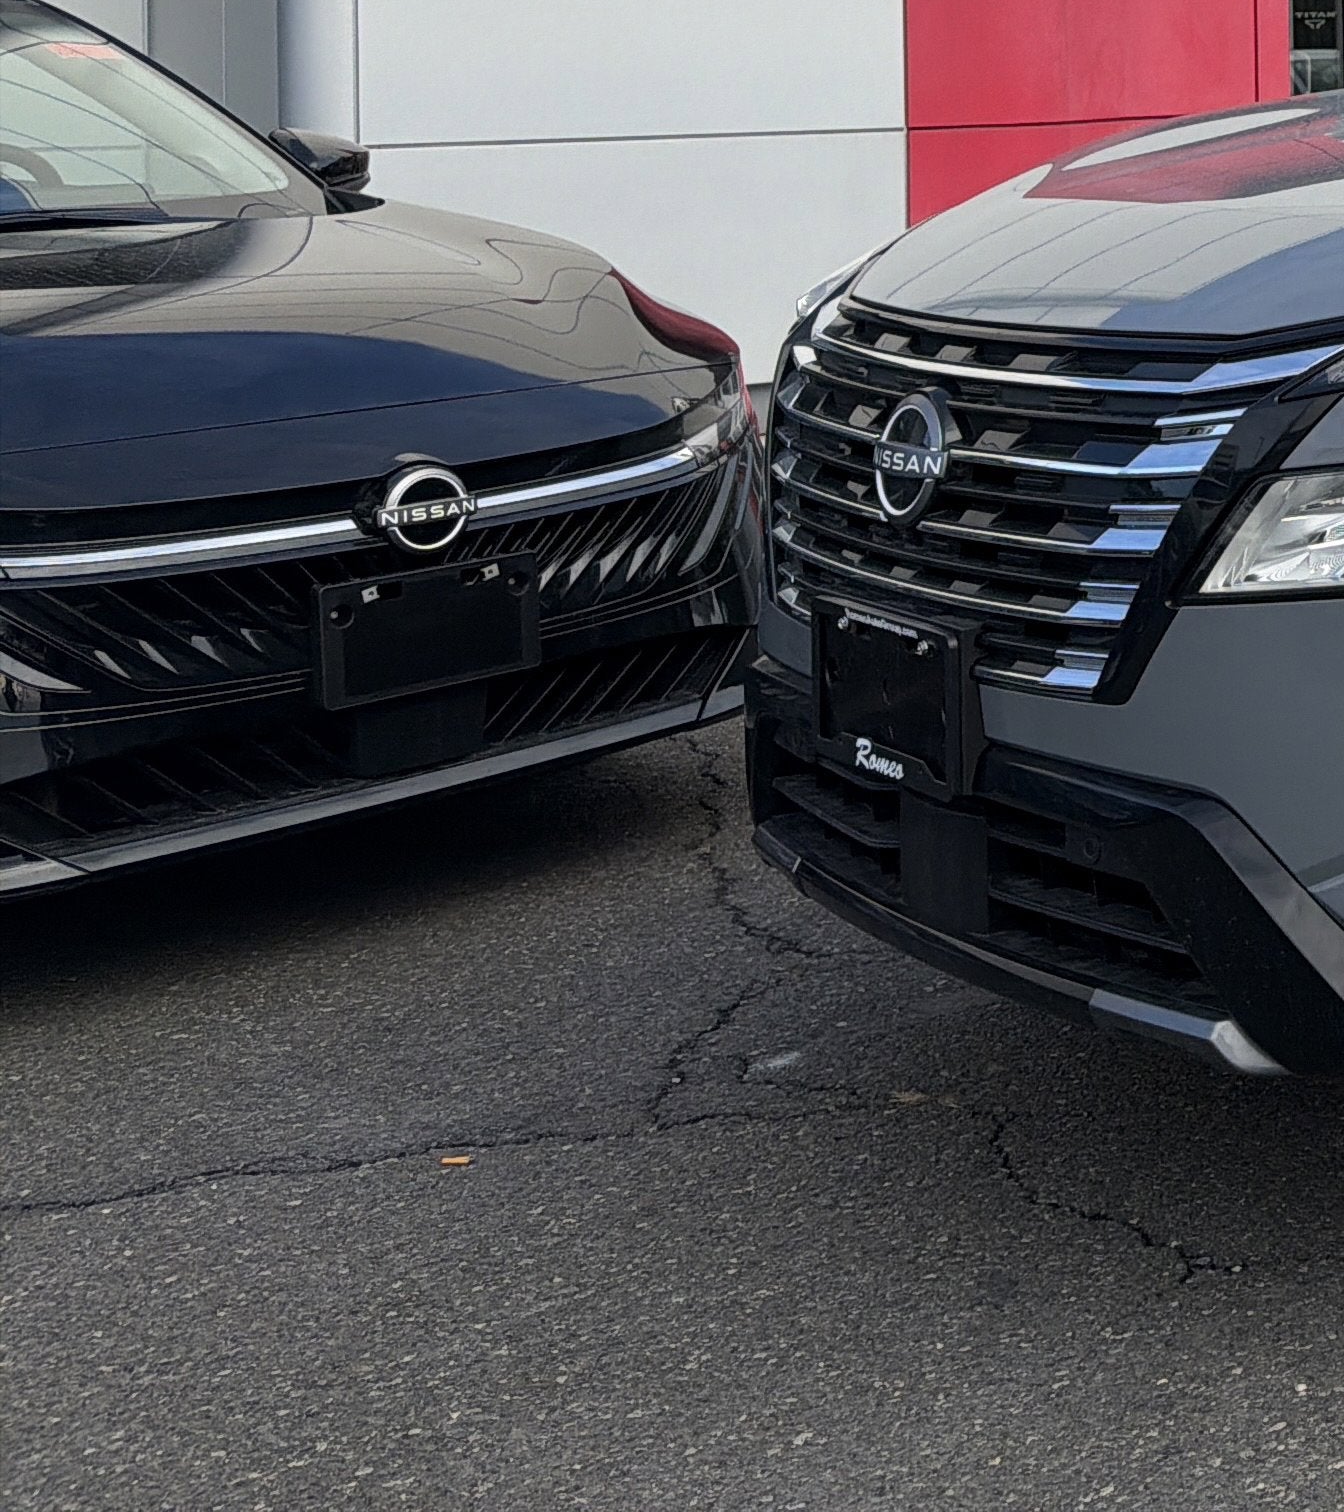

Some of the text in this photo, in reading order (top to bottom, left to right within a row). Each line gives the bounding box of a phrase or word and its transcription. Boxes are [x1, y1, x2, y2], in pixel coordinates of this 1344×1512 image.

[873, 445, 942, 475] NISSAN
[381, 499, 476, 526] NISSAN
[855, 737, 904, 780] Romeo
